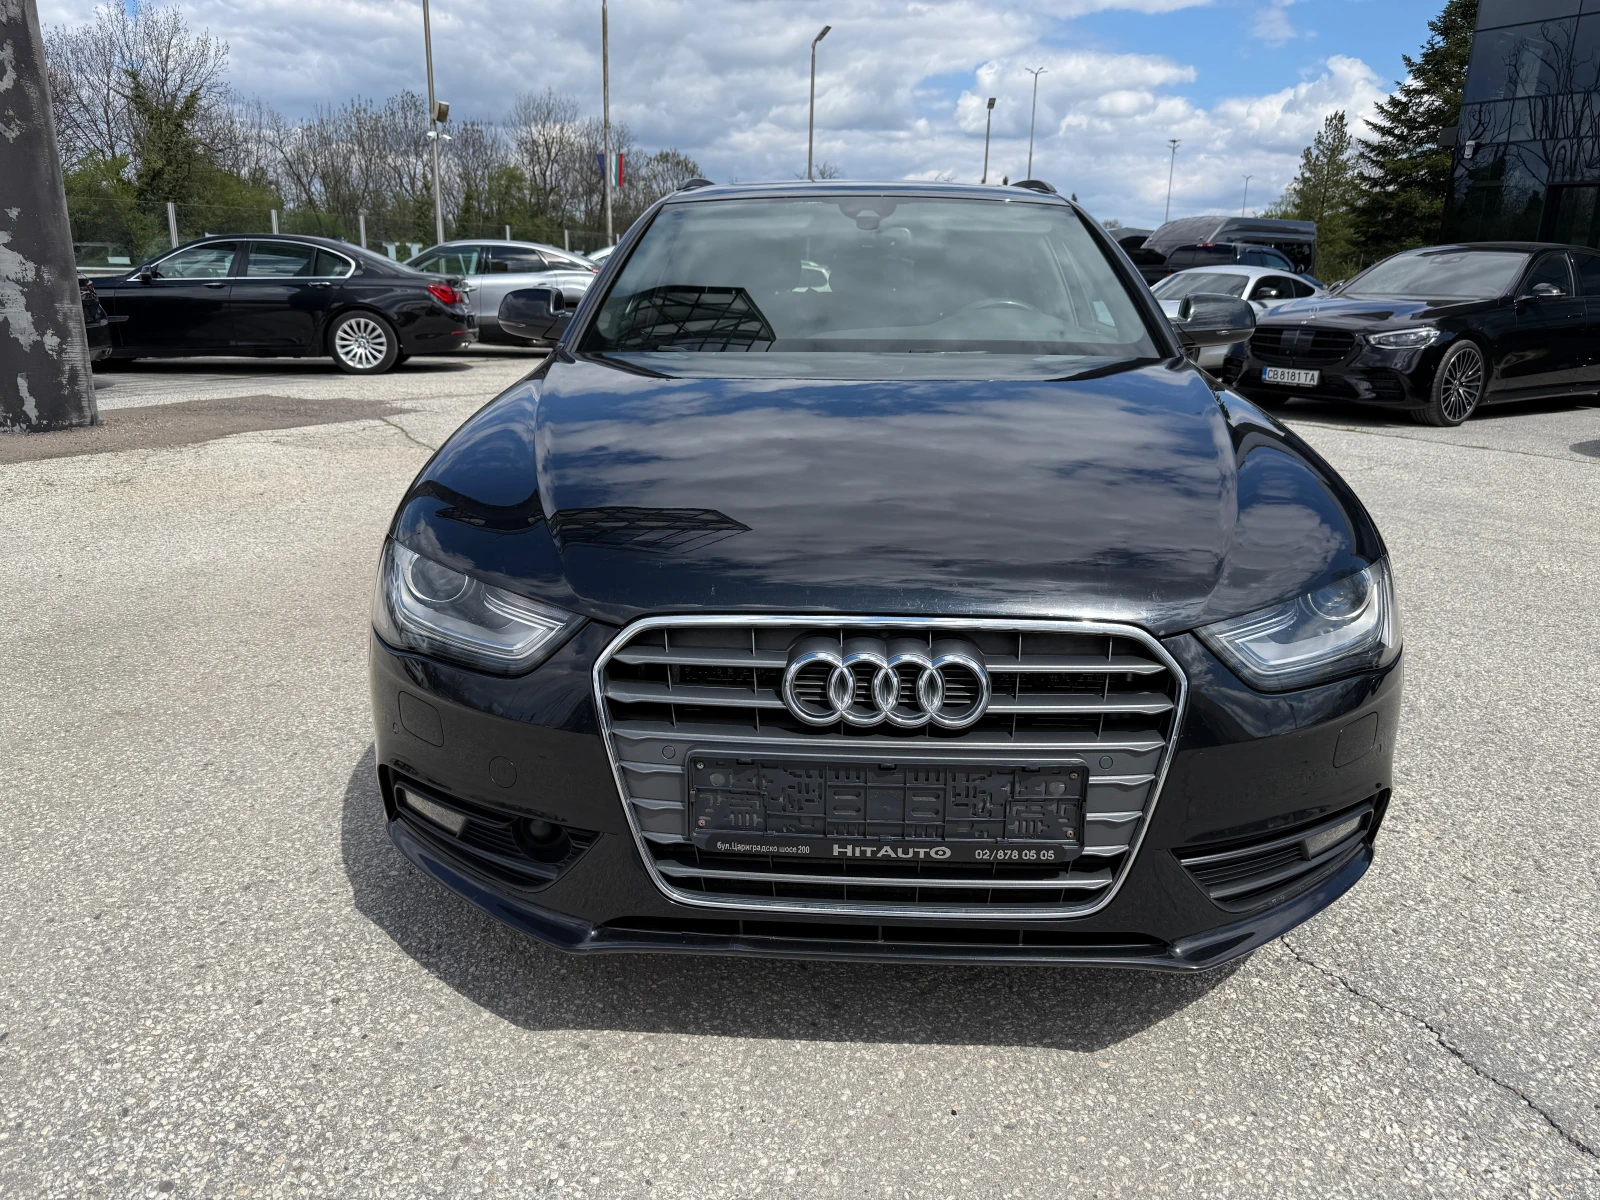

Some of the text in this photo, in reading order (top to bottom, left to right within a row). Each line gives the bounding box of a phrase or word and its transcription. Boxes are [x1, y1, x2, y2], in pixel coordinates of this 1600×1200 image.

[779, 846, 797, 854] шосе
[797, 845, 810, 854] 200
[975, 849, 1055, 860] 02/878 05 05
